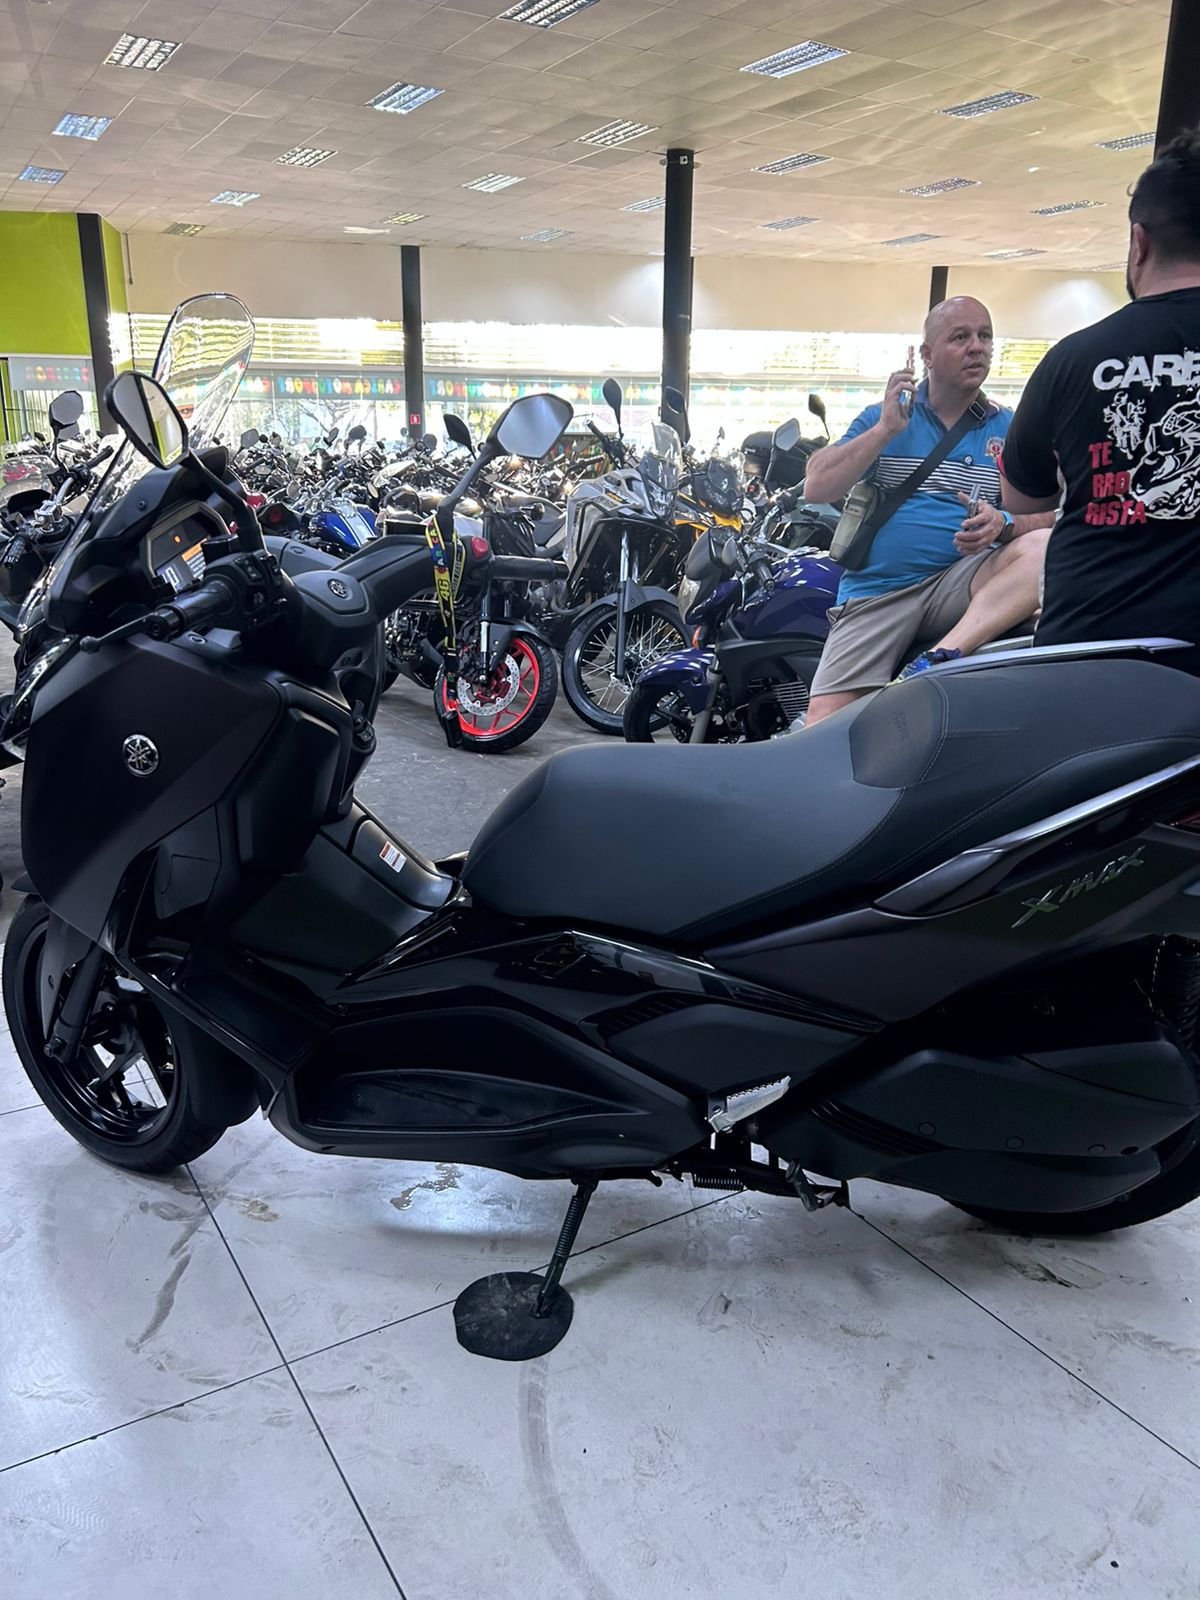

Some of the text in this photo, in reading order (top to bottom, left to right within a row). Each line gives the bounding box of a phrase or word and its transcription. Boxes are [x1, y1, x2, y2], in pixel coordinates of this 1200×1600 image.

[1088, 441, 1113, 469] TE
[1085, 501, 1147, 526] RISTA
[438, 578, 450, 601] 46
